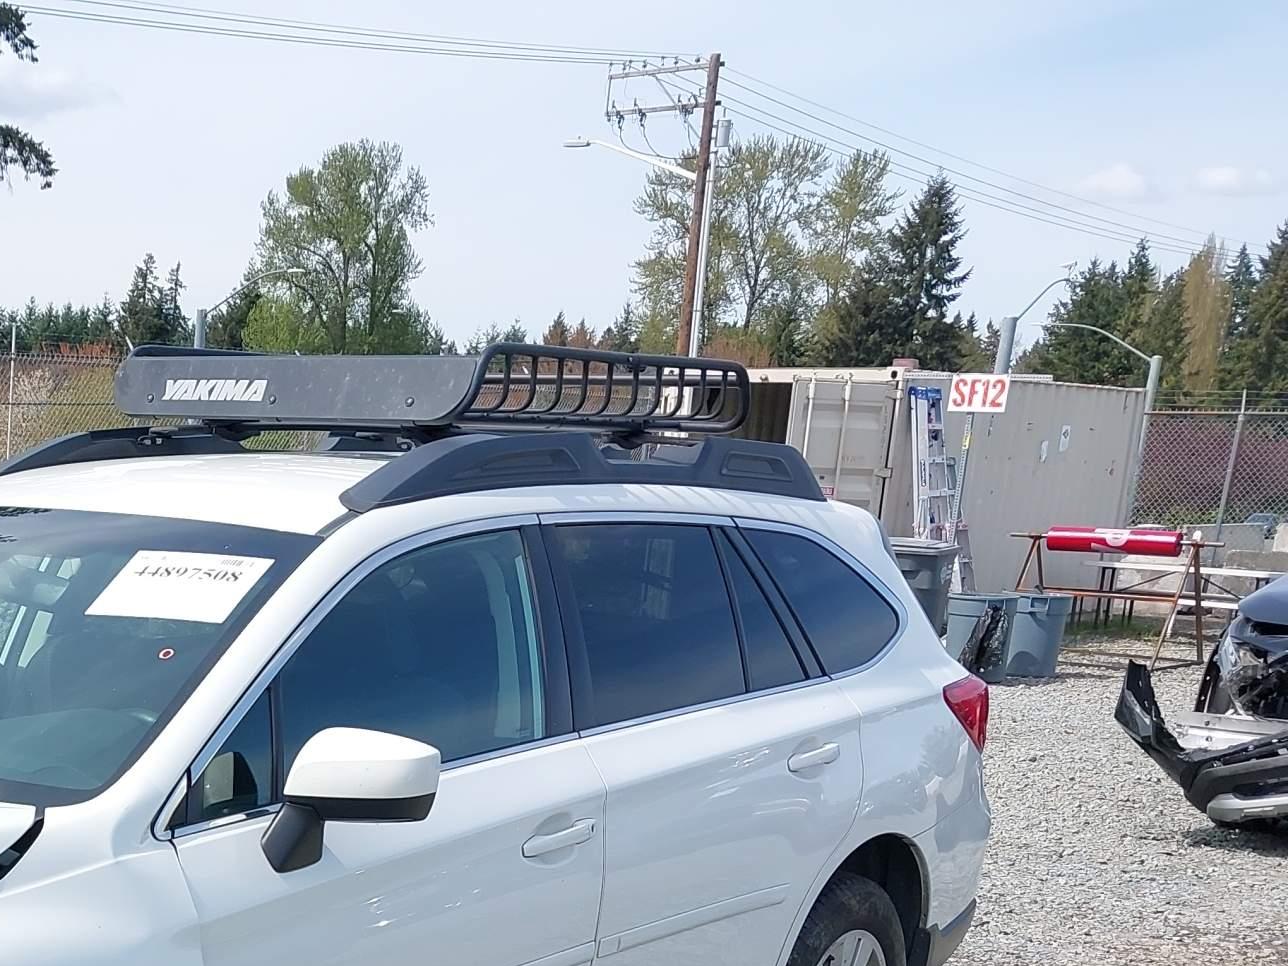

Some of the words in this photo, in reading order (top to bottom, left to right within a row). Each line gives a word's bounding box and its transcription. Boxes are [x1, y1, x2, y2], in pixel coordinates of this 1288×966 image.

[161, 379, 268, 402] YAKIMA
[952, 378, 1006, 407] SF12
[134, 565, 243, 582] 44897508
